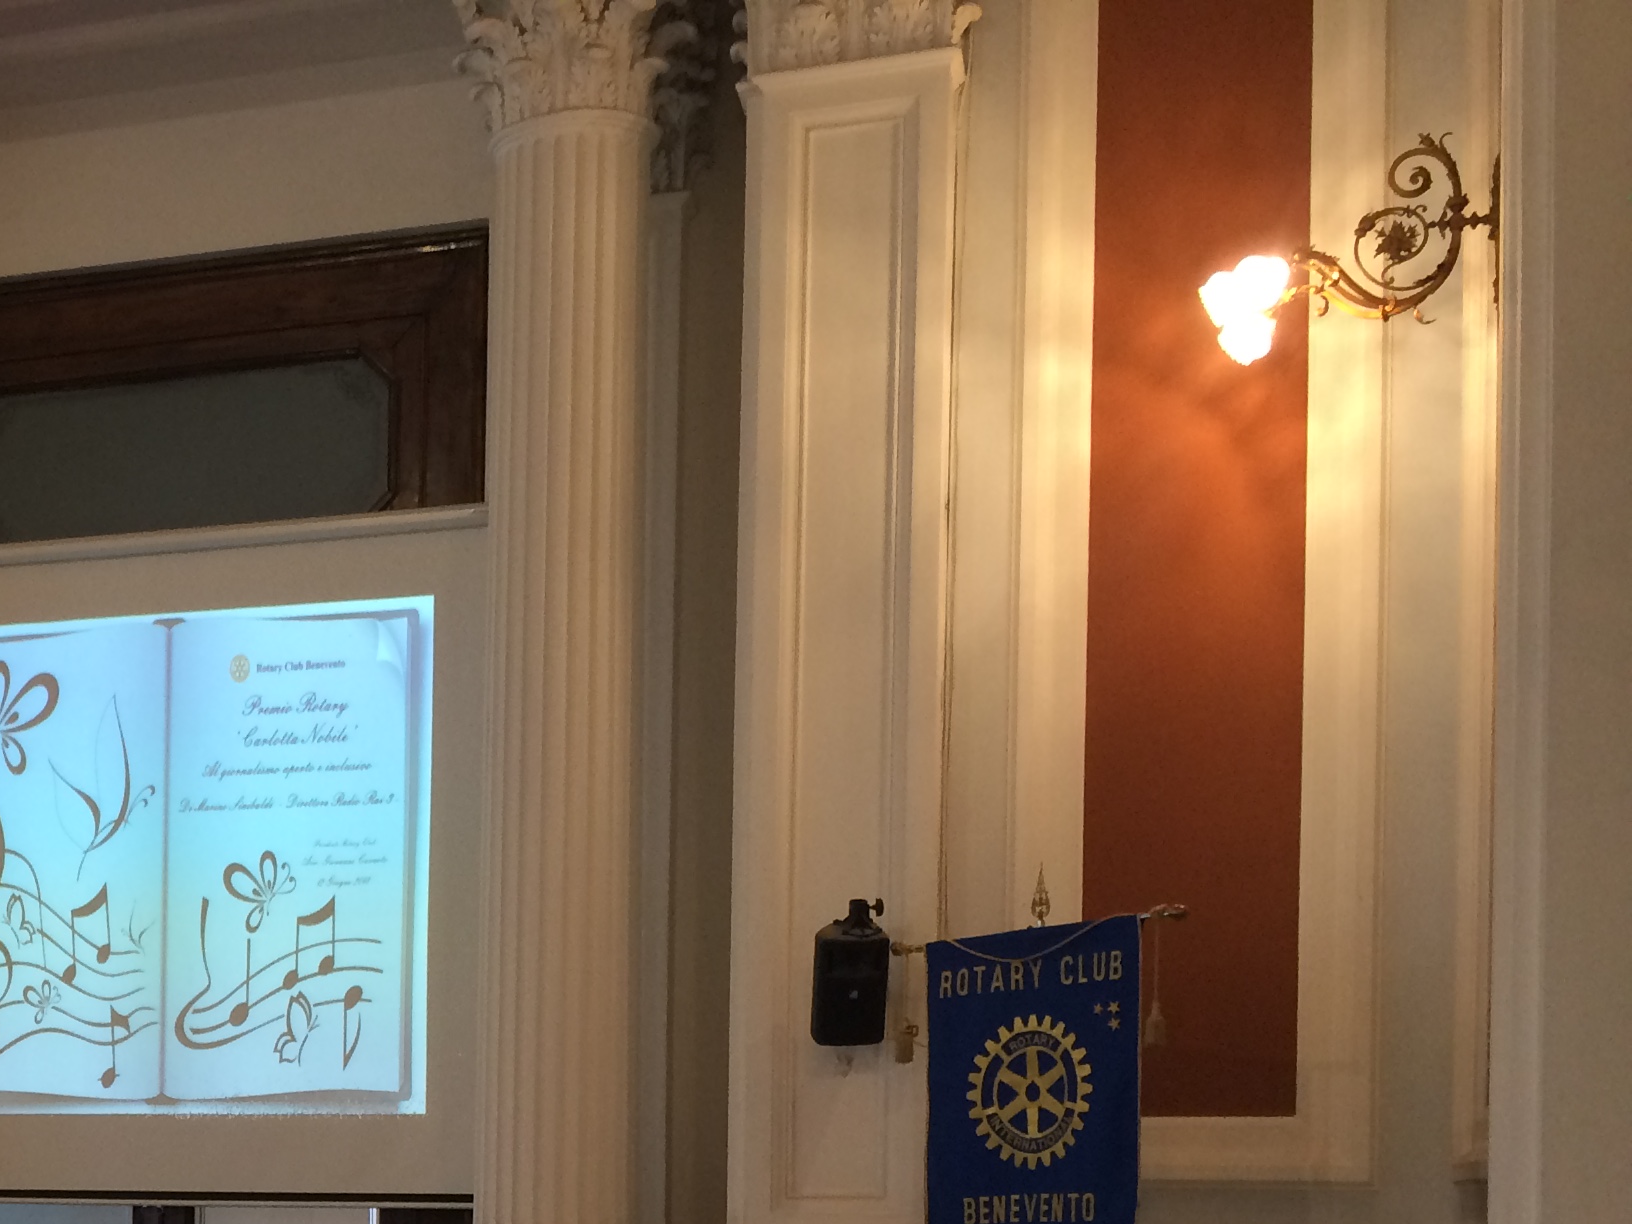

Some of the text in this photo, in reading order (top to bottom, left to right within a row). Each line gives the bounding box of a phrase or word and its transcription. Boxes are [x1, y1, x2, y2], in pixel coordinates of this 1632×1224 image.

[284, 661, 304, 672] Club
[242, 691, 349, 718] Premio Rotary
[939, 950, 1123, 999] ROTARY CLUB
[1009, 1034, 1057, 1051] ROTARY
[963, 1192, 1095, 1224] BENEVENTO
